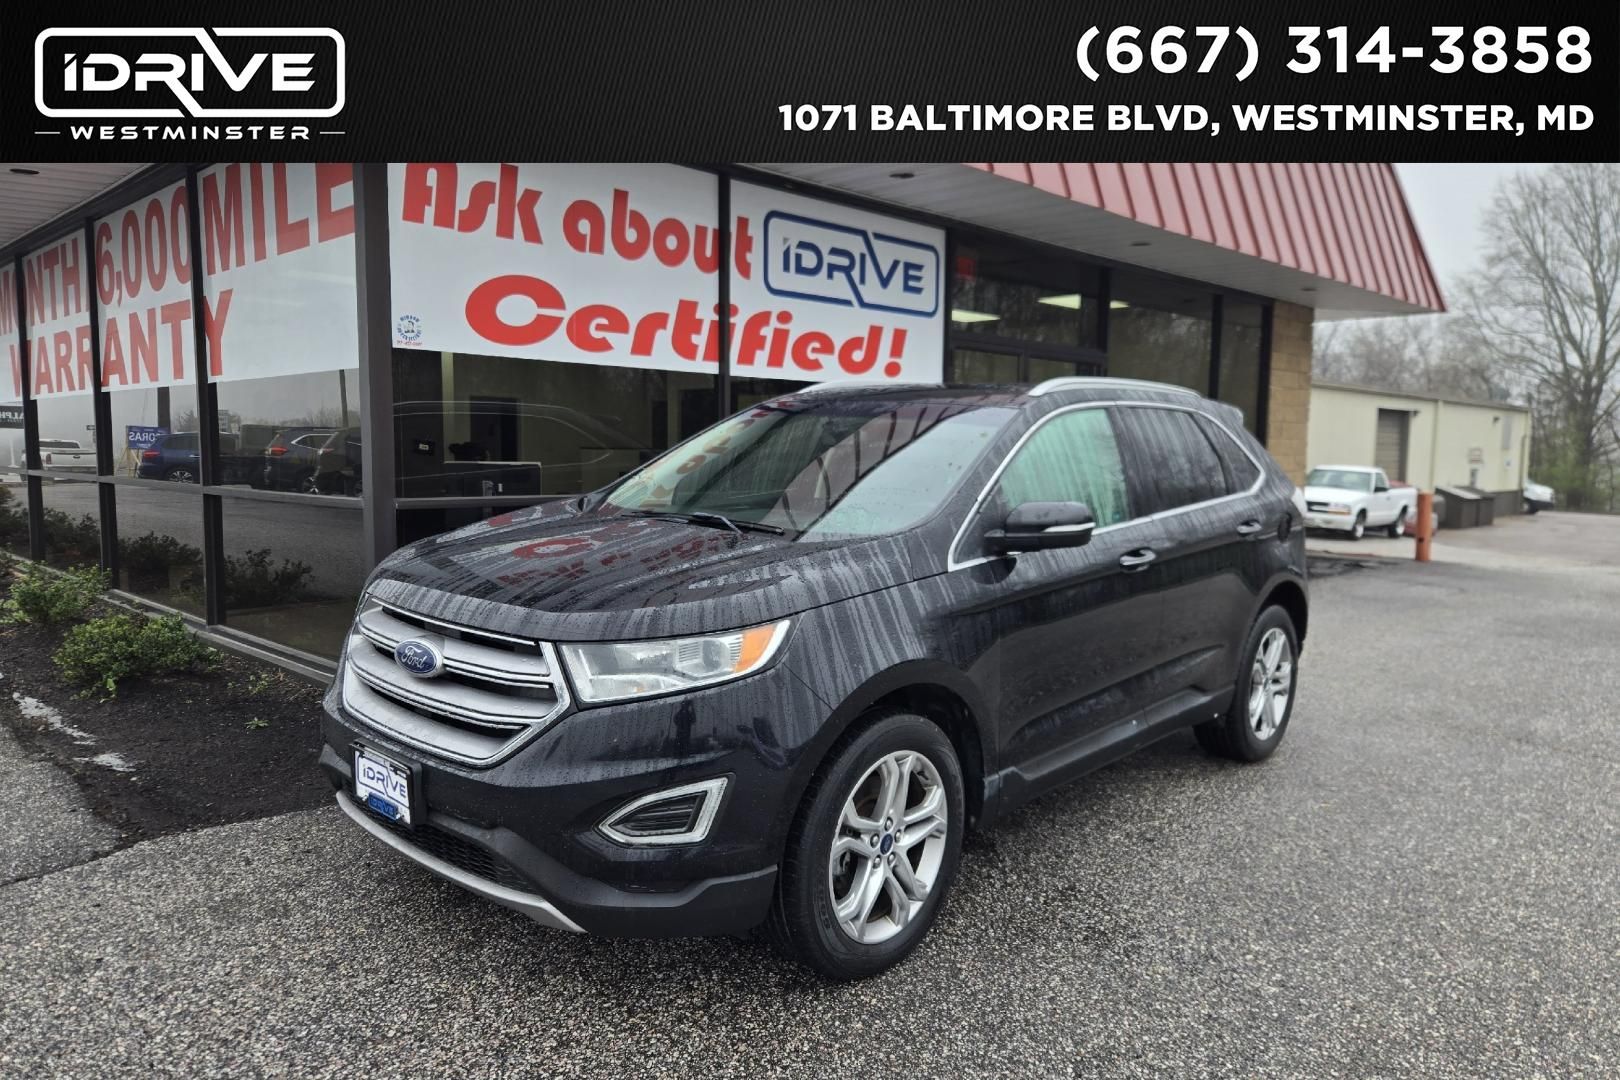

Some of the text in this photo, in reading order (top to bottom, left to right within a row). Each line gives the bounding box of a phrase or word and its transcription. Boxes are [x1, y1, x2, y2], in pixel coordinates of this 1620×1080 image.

[402, 162, 753, 281] Ask about
[465, 274, 908, 378] Certified!
[401, 645, 428, 668] Ford
